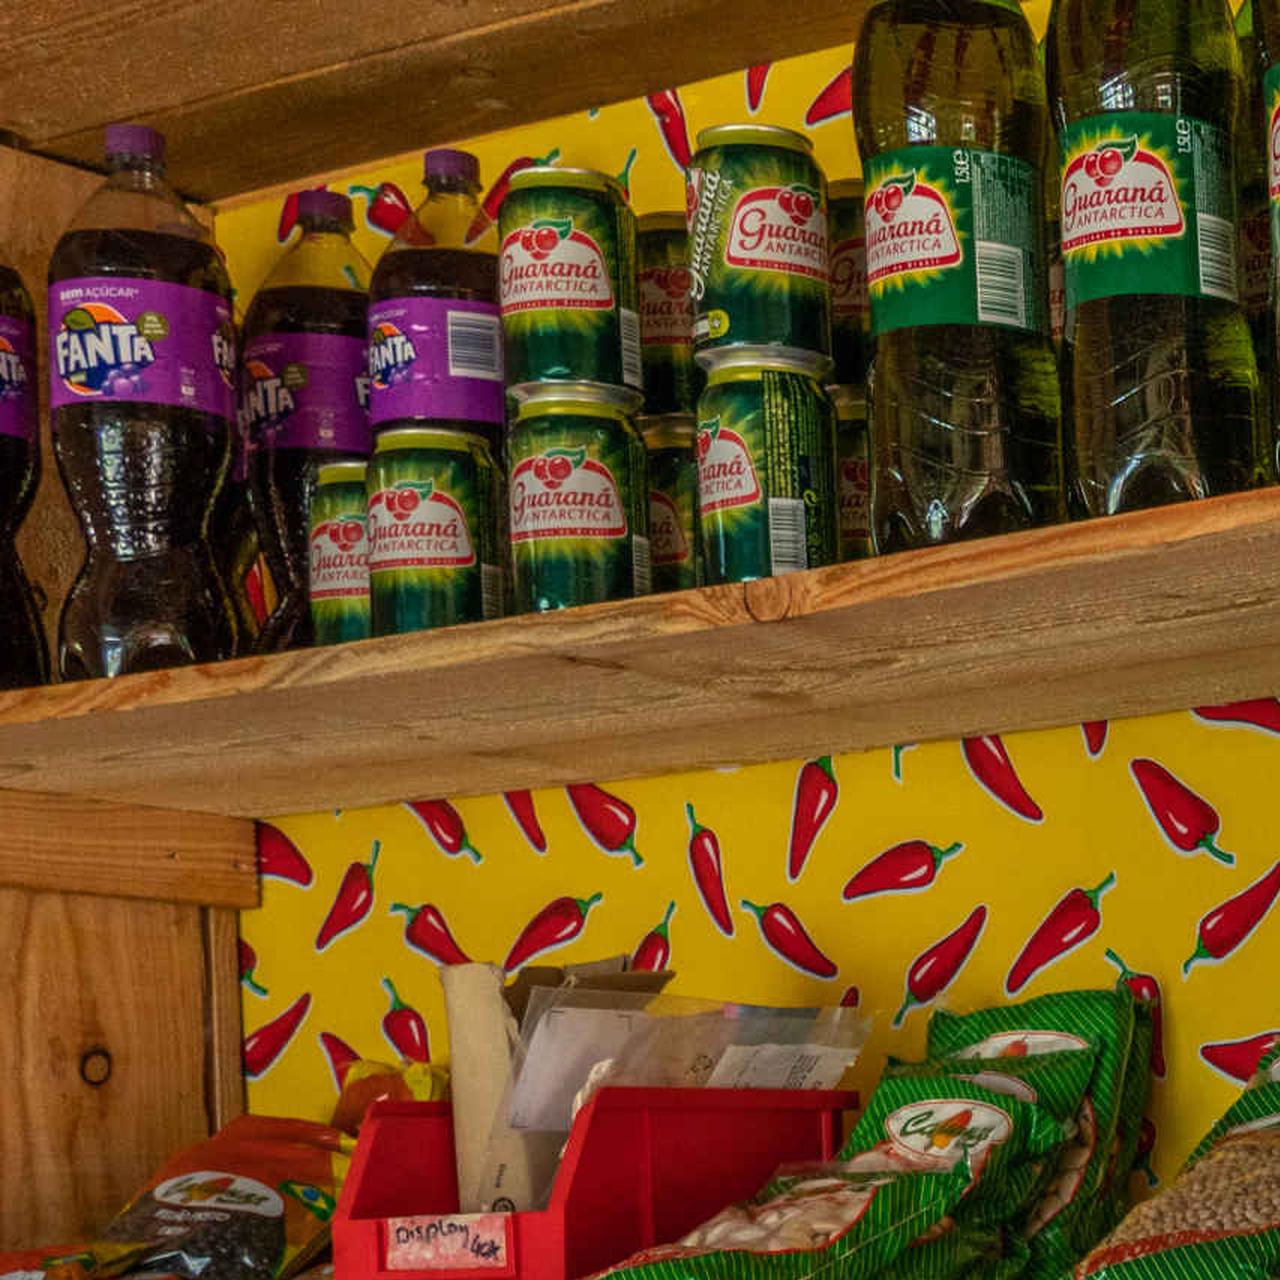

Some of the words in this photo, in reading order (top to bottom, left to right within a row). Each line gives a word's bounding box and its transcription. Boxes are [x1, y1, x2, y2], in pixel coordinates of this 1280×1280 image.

[1064, 180, 1167, 232] Guaraná
[1077, 205, 1166, 228] ANTARCTICA
[56, 324, 156, 377] FANTA
[370, 335, 417, 375] ANTA
[512, 481, 615, 527] Guaraná
[395, 1221, 470, 1249] Display
